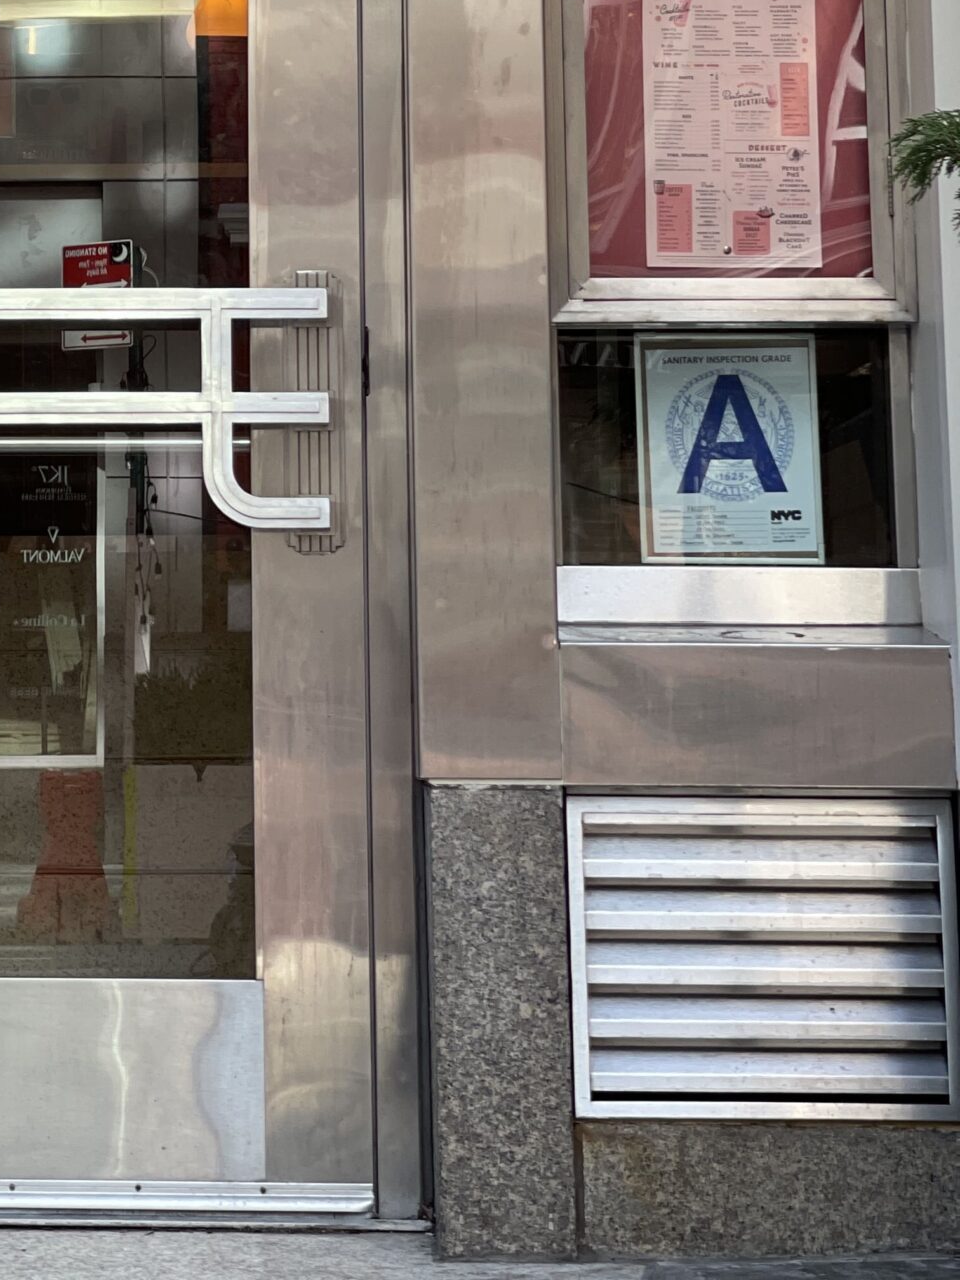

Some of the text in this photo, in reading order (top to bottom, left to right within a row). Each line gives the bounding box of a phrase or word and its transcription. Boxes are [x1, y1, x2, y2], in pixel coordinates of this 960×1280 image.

[662, 354, 792, 365] SANITARY INSPECTION GRADE
[677, 374, 789, 494] A
[771, 509, 802, 522] NYC
